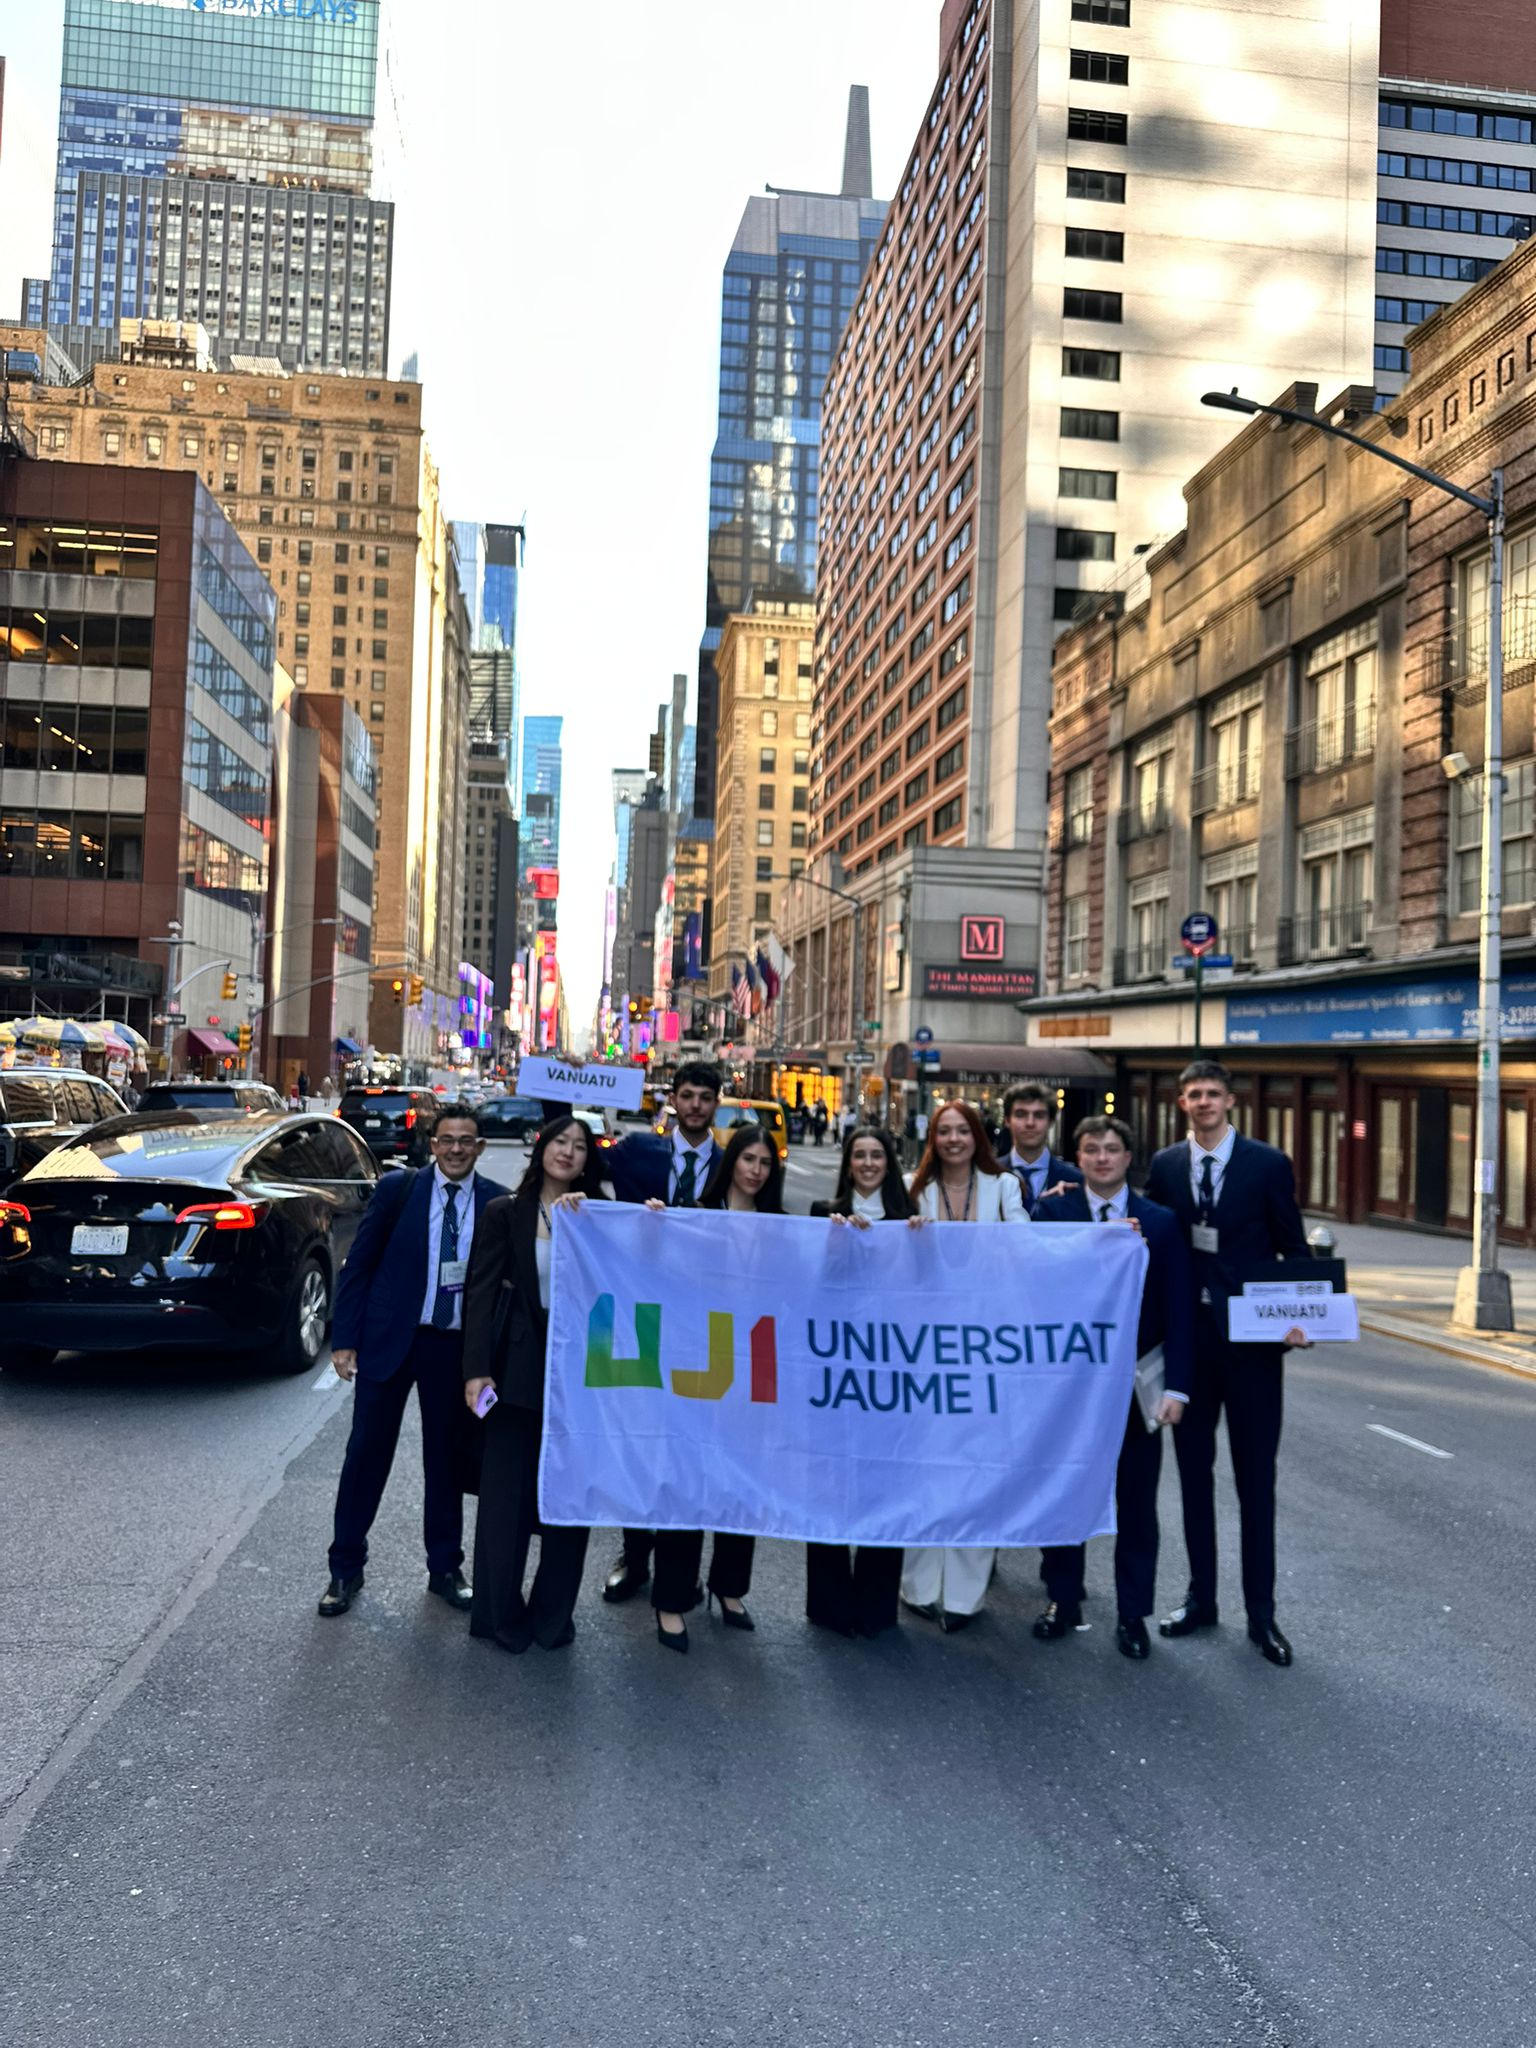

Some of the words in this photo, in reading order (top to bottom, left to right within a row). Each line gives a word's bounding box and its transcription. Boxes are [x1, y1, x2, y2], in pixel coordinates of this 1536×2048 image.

[968, 923, 997, 952] M
[957, 971, 1034, 985] MANHATTAN
[547, 1066, 617, 1089] VANUATU
[958, 1070, 980, 1082] Bar
[1255, 1303, 1328, 1320] VANUATU
[807, 1317, 1117, 1366] UNIVERSITAT
[808, 1366, 974, 1415] JAUME
[988, 1374, 999, 1414] I
